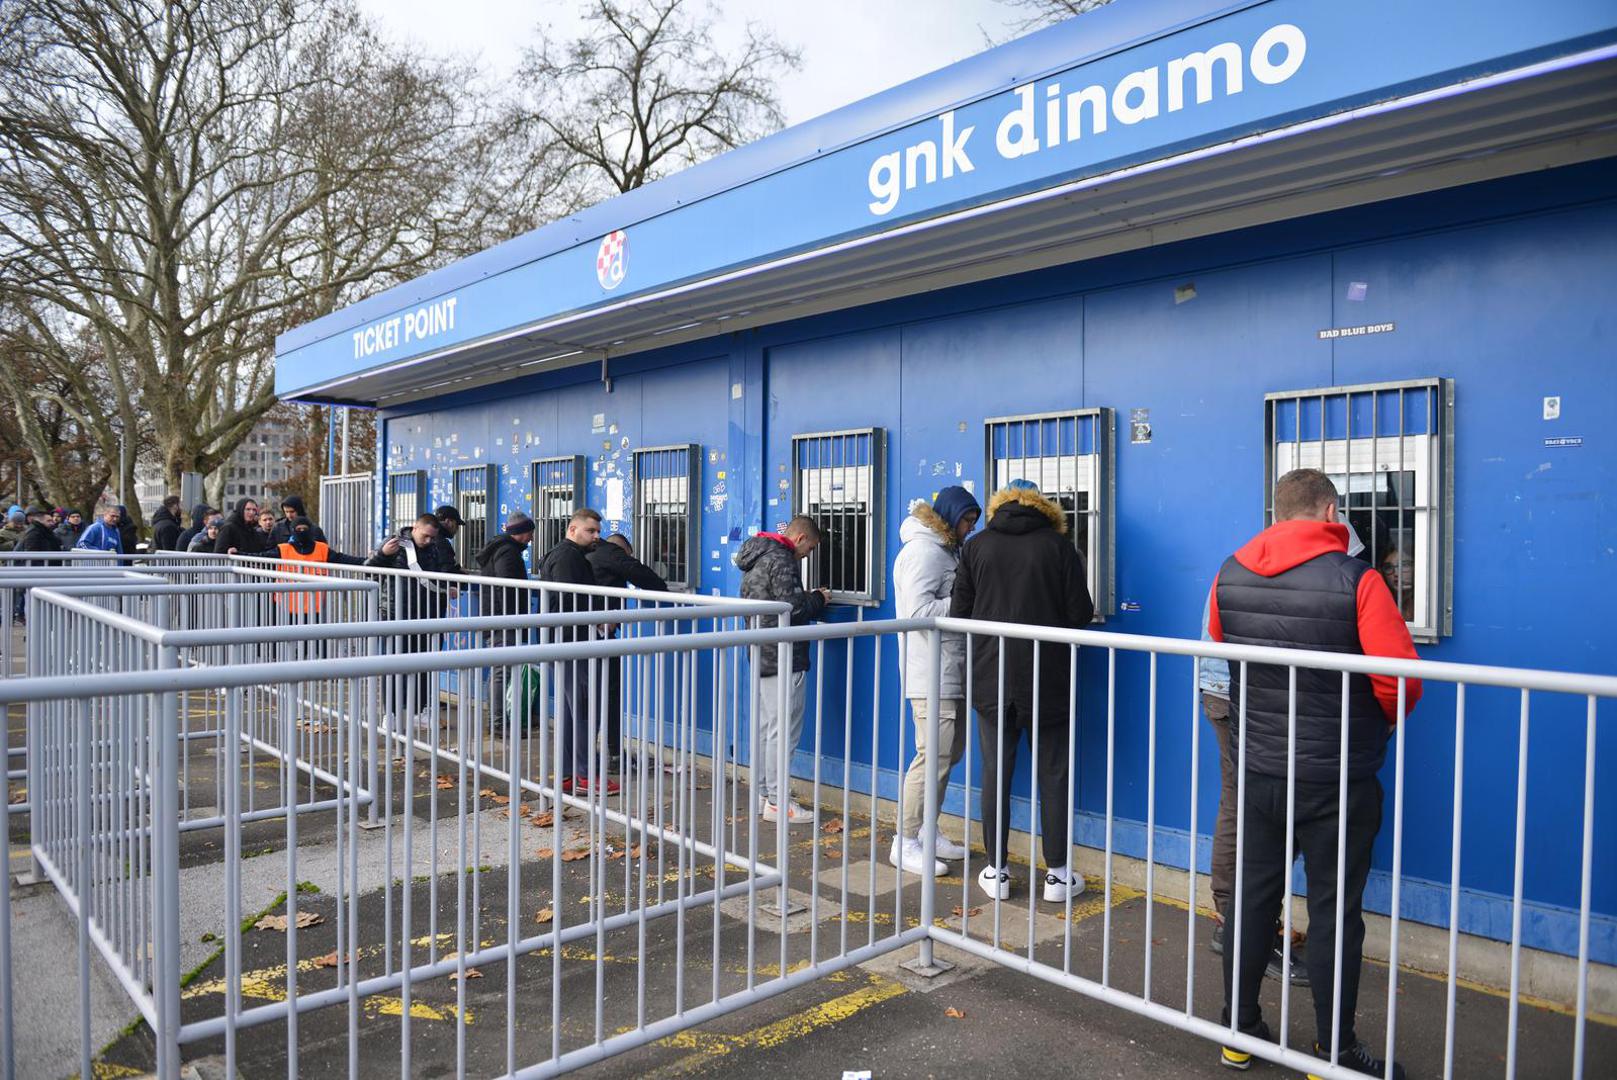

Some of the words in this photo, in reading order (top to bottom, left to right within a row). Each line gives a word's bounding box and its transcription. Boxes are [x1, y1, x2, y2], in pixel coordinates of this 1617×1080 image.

[867, 109, 976, 216] gnk
[996, 23, 1307, 159] dinamo
[353, 317, 401, 360] TICKET
[404, 297, 457, 343] POINT
[1320, 329, 1340, 339] BAD
[1341, 326, 1366, 336] BLUE
[1367, 323, 1394, 333] BOYS
